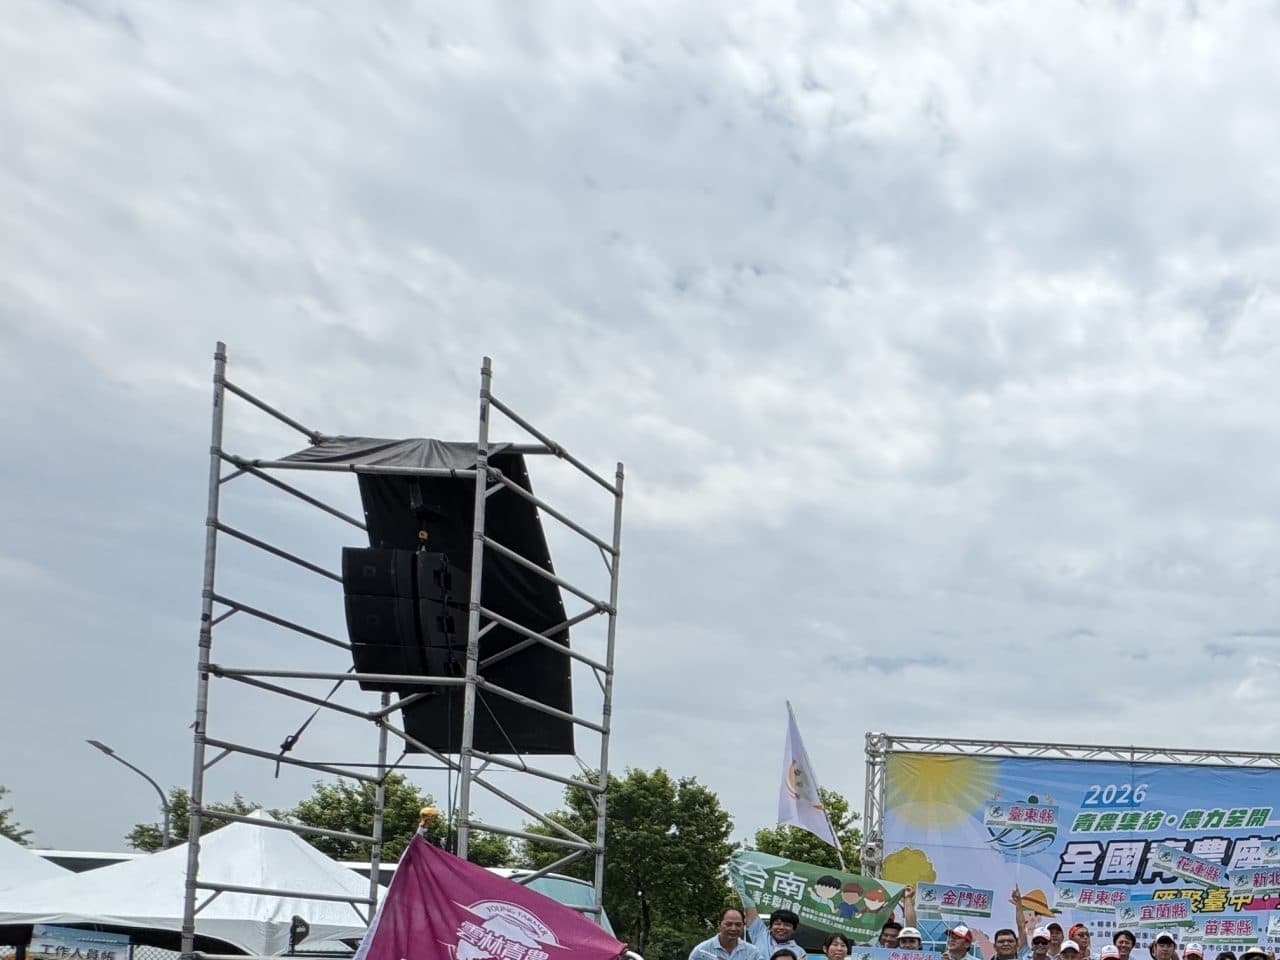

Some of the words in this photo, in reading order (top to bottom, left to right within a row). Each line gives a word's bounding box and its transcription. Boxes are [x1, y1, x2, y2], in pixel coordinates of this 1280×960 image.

[1085, 784, 1148, 804] 2026
[1008, 806, 1053, 824] 臺東縣
[1176, 855, 1221, 883] 花蓮縣
[943, 888, 989, 909] 金門縣
[1078, 888, 1126, 906] 屏東縣
[1140, 902, 1188, 921] 宜蘭縣
[1205, 919, 1252, 937] 苗栗縣
